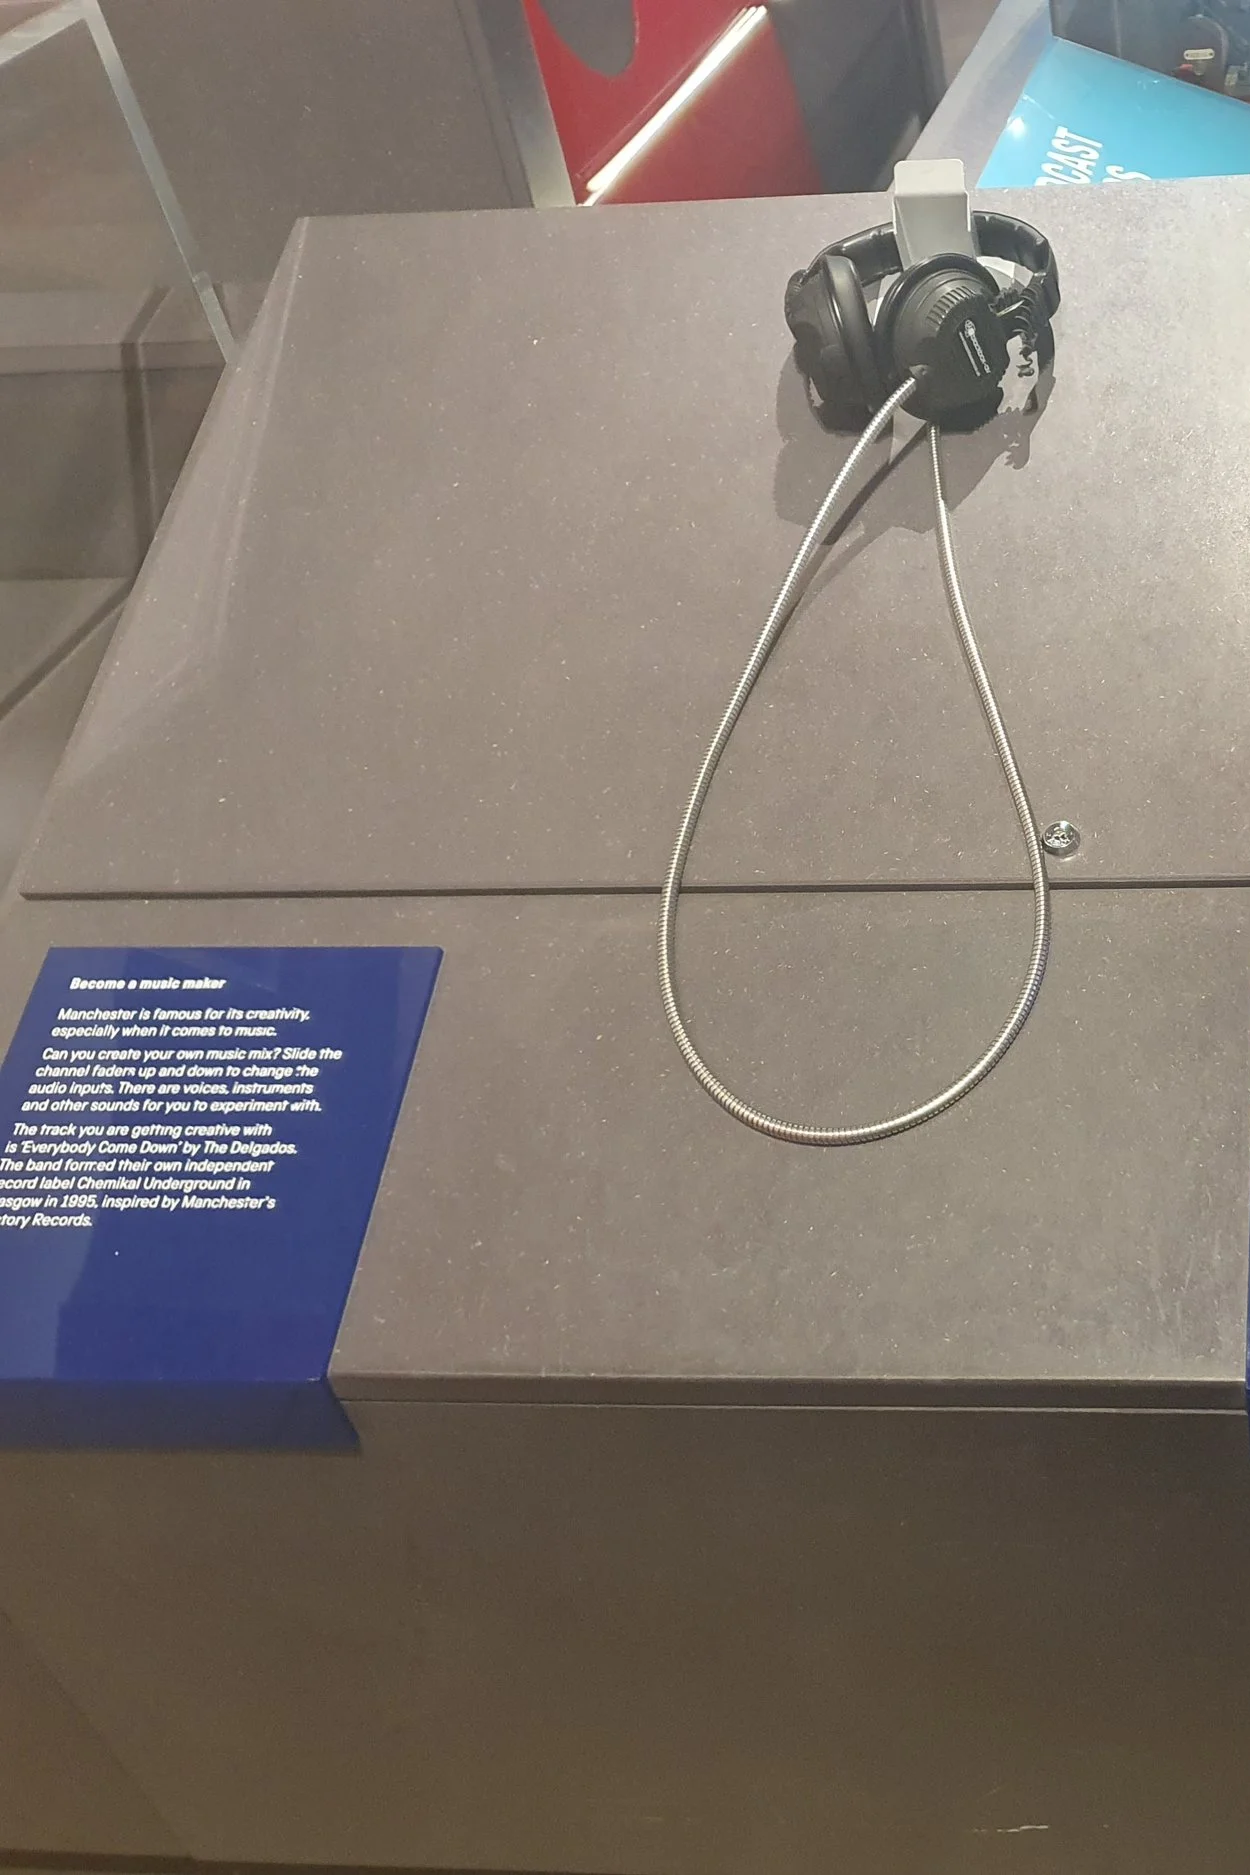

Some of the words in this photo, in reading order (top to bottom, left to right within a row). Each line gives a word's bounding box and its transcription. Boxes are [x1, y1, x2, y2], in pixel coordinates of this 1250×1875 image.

[69, 977, 126, 990] Become
[127, 979, 138, 990] a
[138, 976, 181, 990] music
[181, 976, 227, 990] maker
[57, 1007, 138, 1021] Manchester
[138, 1007, 152, 1021] is
[152, 1007, 203, 1021] famous
[203, 1007, 226, 1021] for
[225, 1007, 245, 1021] its
[51, 1023, 121, 1040] especially
[121, 1024, 158, 1037] when
[158, 1024, 172, 1037] it
[171, 1026, 217, 1037] comes
[217, 1025, 234, 1037] to
[234, 1026, 278, 1037] music.
[42, 1047, 69, 1061] Can
[69, 1049, 97, 1064] you
[97, 1048, 142, 1061] create
[142, 1049, 176, 1063] your
[175, 1049, 205, 1061] own
[205, 1047, 248, 1061] music
[247, 1046, 283, 1060] mix?
[281, 1046, 318, 1061] Slide
[318, 1047, 343, 1060] the
[35, 1064, 91, 1078] channel
[91, 1063, 137, 1078] faders
[137, 1066, 157, 1080] up
[157, 1064, 187, 1078] and
[186, 1064, 224, 1078] down
[225, 1065, 242, 1078] to
[241, 1064, 294, 1081] change
[294, 1064, 320, 1078] the
[27, 1081, 68, 1095] audio
[68, 1080, 115, 1098] inputs.
[118, 1080, 157, 1095] There
[157, 1083, 181, 1095] are
[182, 1081, 230, 1095] voices,
[231, 1081, 315, 1095] instruments
[20, 1098, 51, 1112] and
[50, 1098, 90, 1112] other
[89, 1098, 141, 1112] sounds
[142, 1098, 165, 1112] for
[164, 1101, 192, 1115] you
[192, 1099, 209, 1112] to
[209, 1098, 290, 1115] experiment
[289, 1098, 323, 1112] with.
[12, 1122, 39, 1136] The
[39, 1122, 78, 1137] track
[77, 1125, 105, 1139] you
[105, 1125, 130, 1137] are
[130, 1123, 183, 1140] getting
[184, 1123, 241, 1137] creative
[242, 1123, 273, 1137] with
[4, 1140, 18, 1154] is
[97, 1140, 138, 1154] Come
[181, 1140, 202, 1157] by
[203, 1140, 229, 1155] The
[229, 1140, 298, 1158] Delgados.
[0, 1157, 25, 1172] The
[24, 1157, 64, 1172] band
[63, 1157, 117, 1172] formed
[117, 1158, 153, 1172] their
[153, 1160, 183, 1172] own
[183, 1158, 276, 1175] independent
[38, 1175, 76, 1190] label
[76, 1175, 143, 1190] Chemikal
[143, 1176, 237, 1194] Underground
[236, 1176, 252, 1191] in
[43, 1194, 59, 1208] in
[59, 1194, 99, 1209] 1995,
[101, 1194, 161, 1212] inspired
[160, 1194, 181, 1212] by
[31, 1212, 93, 1227] Records.
